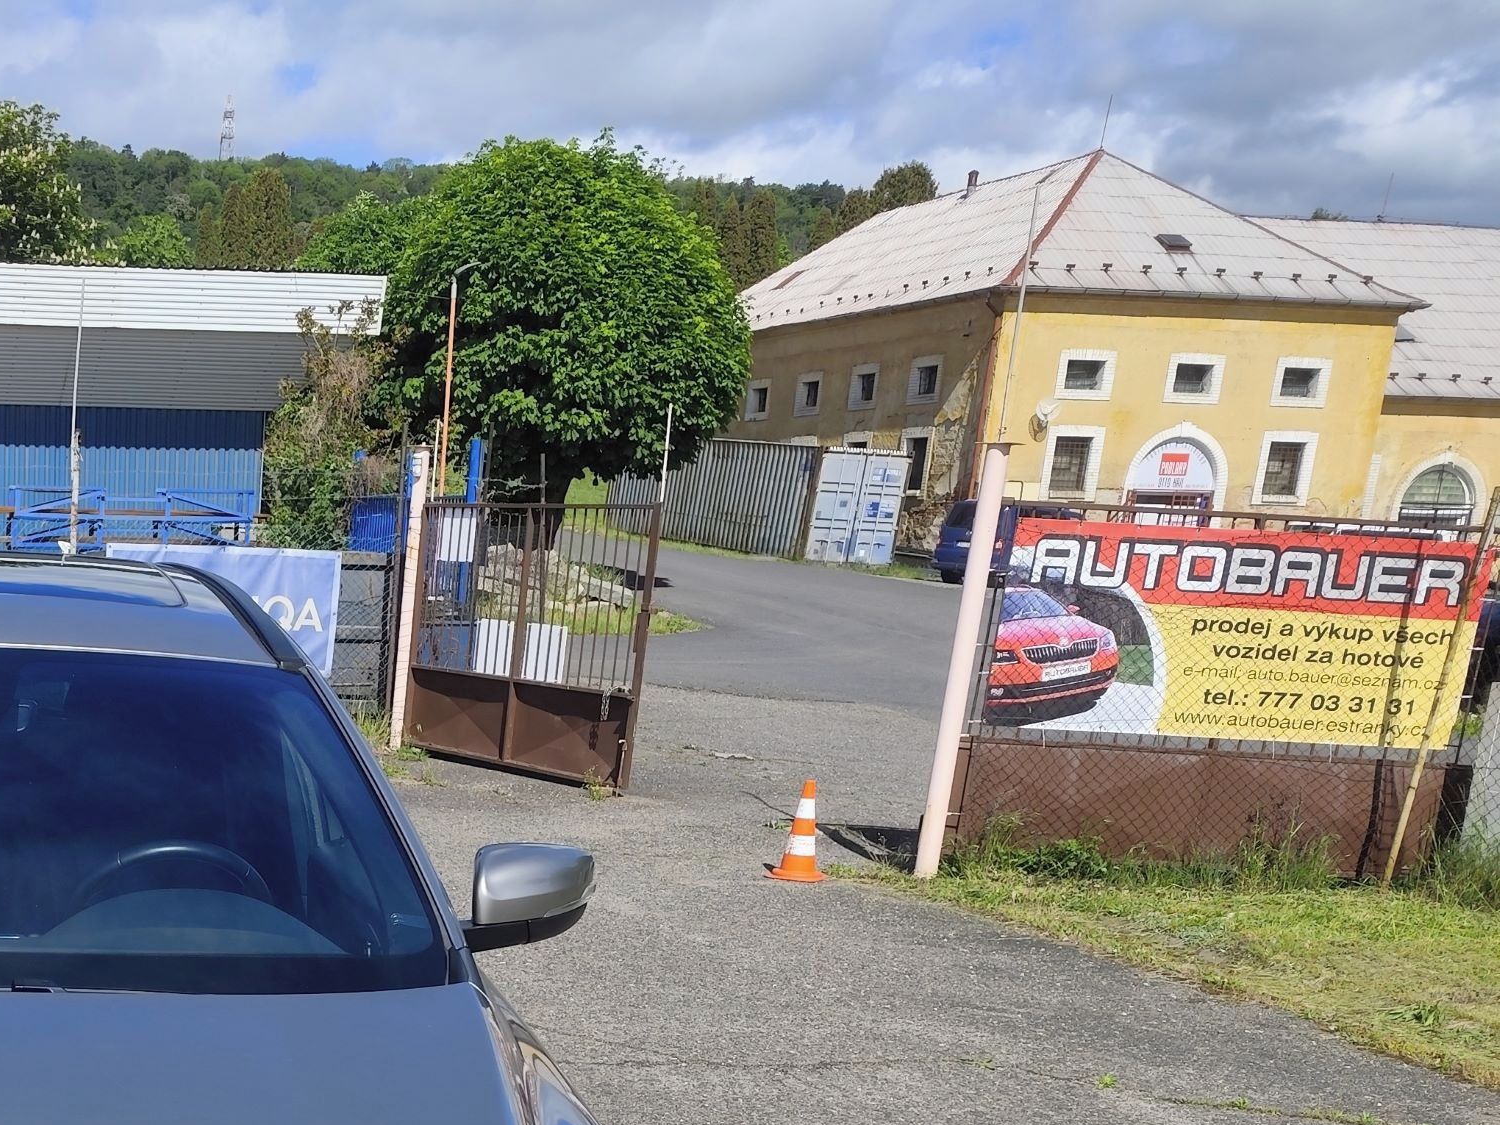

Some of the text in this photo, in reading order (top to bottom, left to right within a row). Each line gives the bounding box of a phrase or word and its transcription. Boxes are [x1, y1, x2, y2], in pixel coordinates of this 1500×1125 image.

[1029, 537, 1468, 608] AUTOBAUER
[1191, 617, 1454, 646] prodej a výkup všech
[1213, 643, 1424, 669] vozidel za hotové
[1183, 666, 1242, 679] e-mail:
[1203, 689, 1415, 716] tel.: 777 03 31 31
